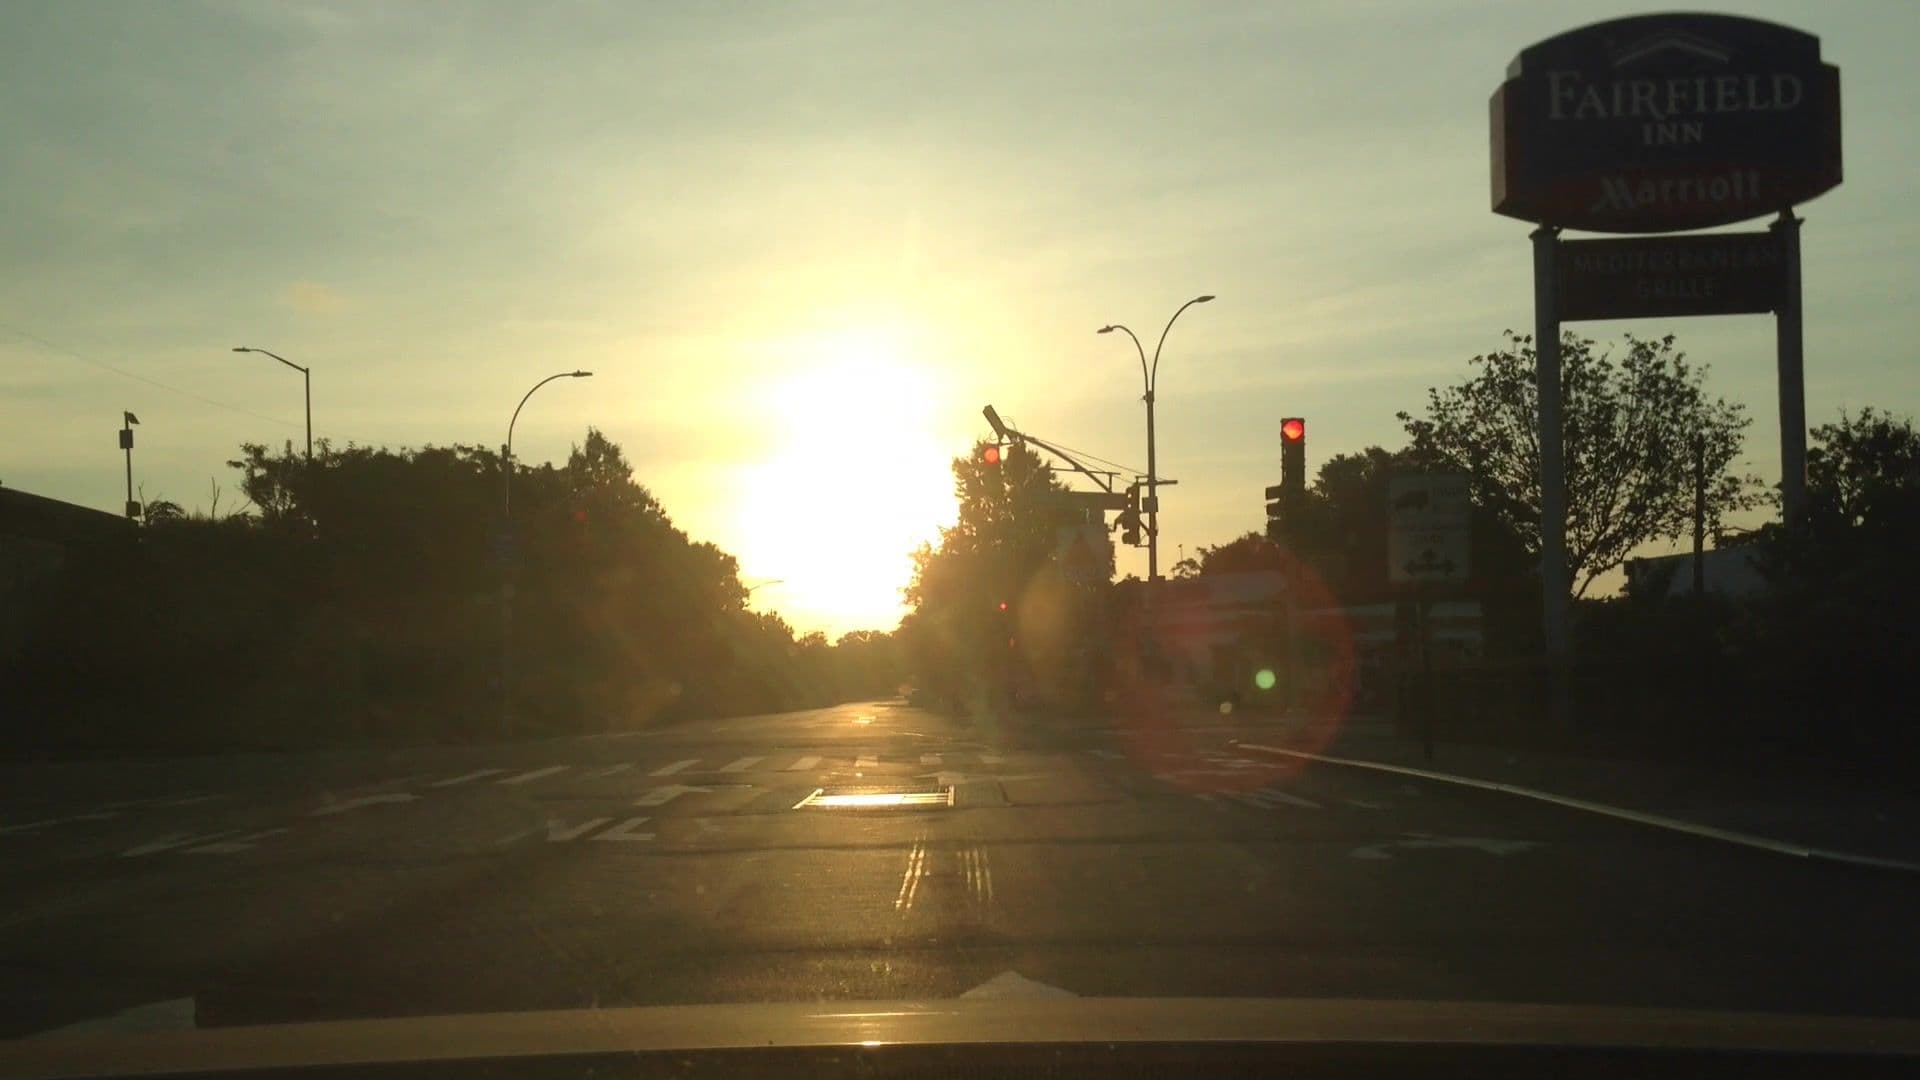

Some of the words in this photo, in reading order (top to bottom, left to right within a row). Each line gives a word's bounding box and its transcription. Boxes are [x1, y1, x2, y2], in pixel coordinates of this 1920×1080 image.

[1546, 69, 1805, 120] FAIRFIELD
[1642, 121, 1704, 145] INN
[1591, 168, 1761, 214] Marriott
